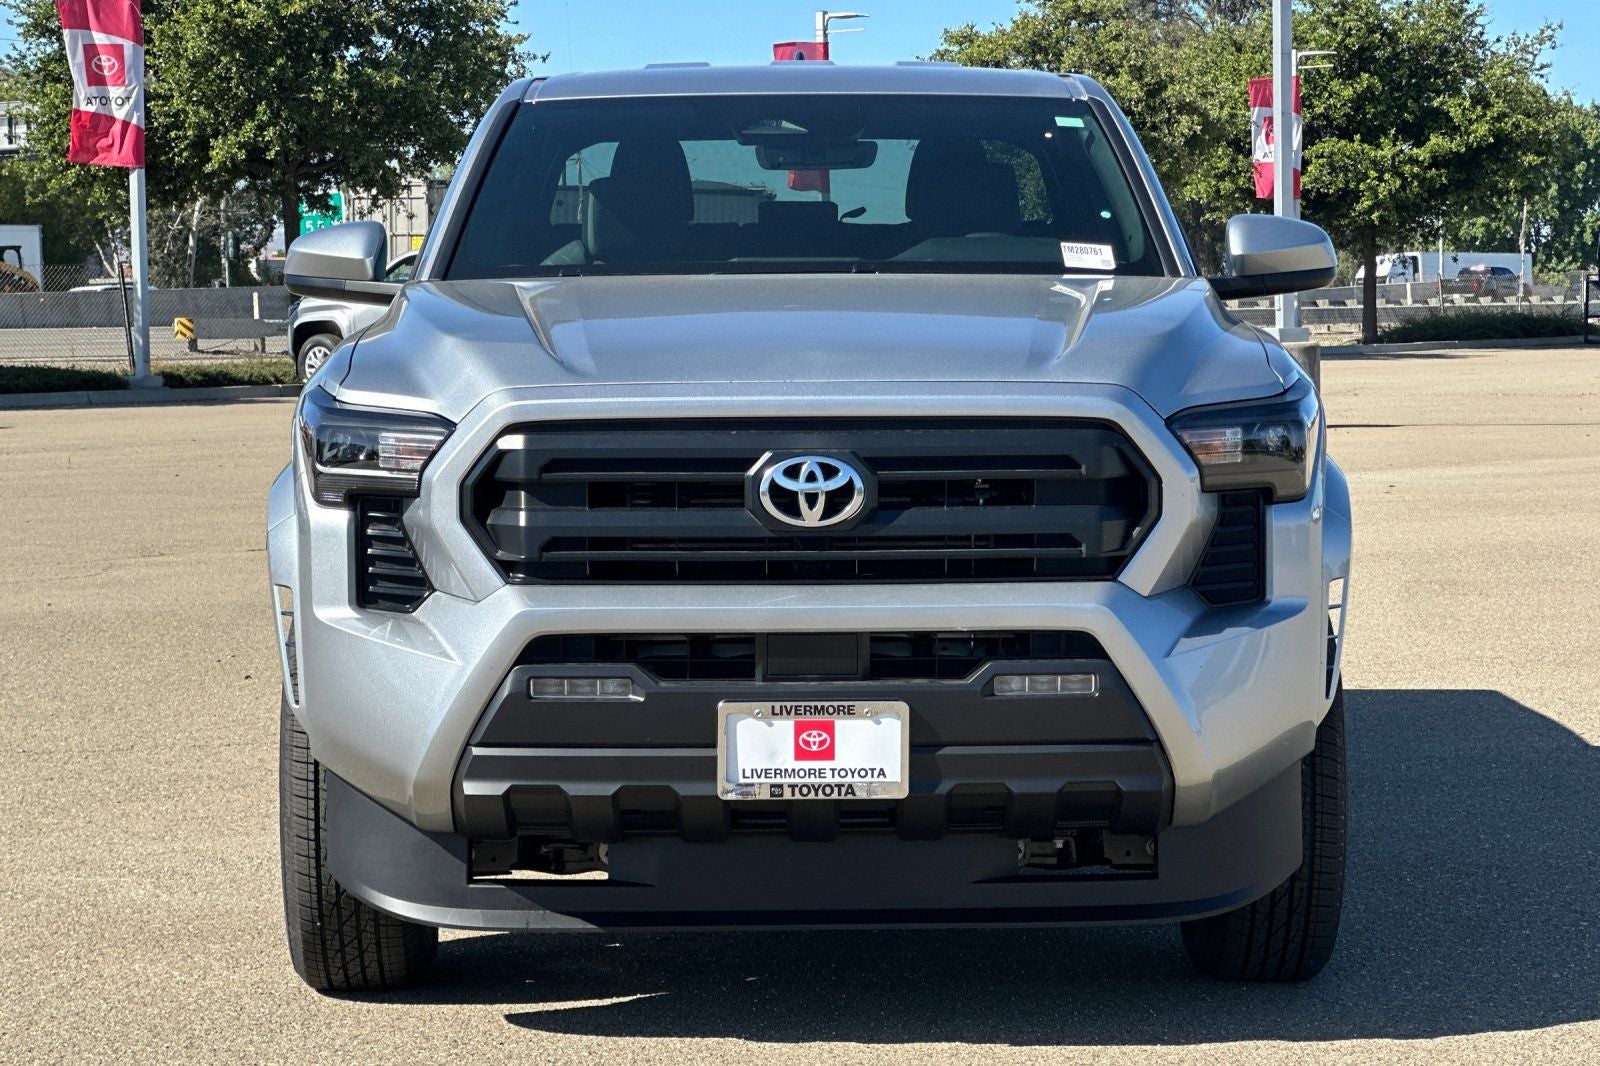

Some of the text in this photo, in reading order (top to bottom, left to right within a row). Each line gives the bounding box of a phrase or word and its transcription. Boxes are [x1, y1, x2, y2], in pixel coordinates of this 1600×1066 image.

[1062, 245, 1103, 256] TM280761
[771, 704, 856, 716] LIVERMORE
[742, 767, 887, 779] LIVERMORE TOYOTA
[788, 784, 857, 797] TOYOTA
